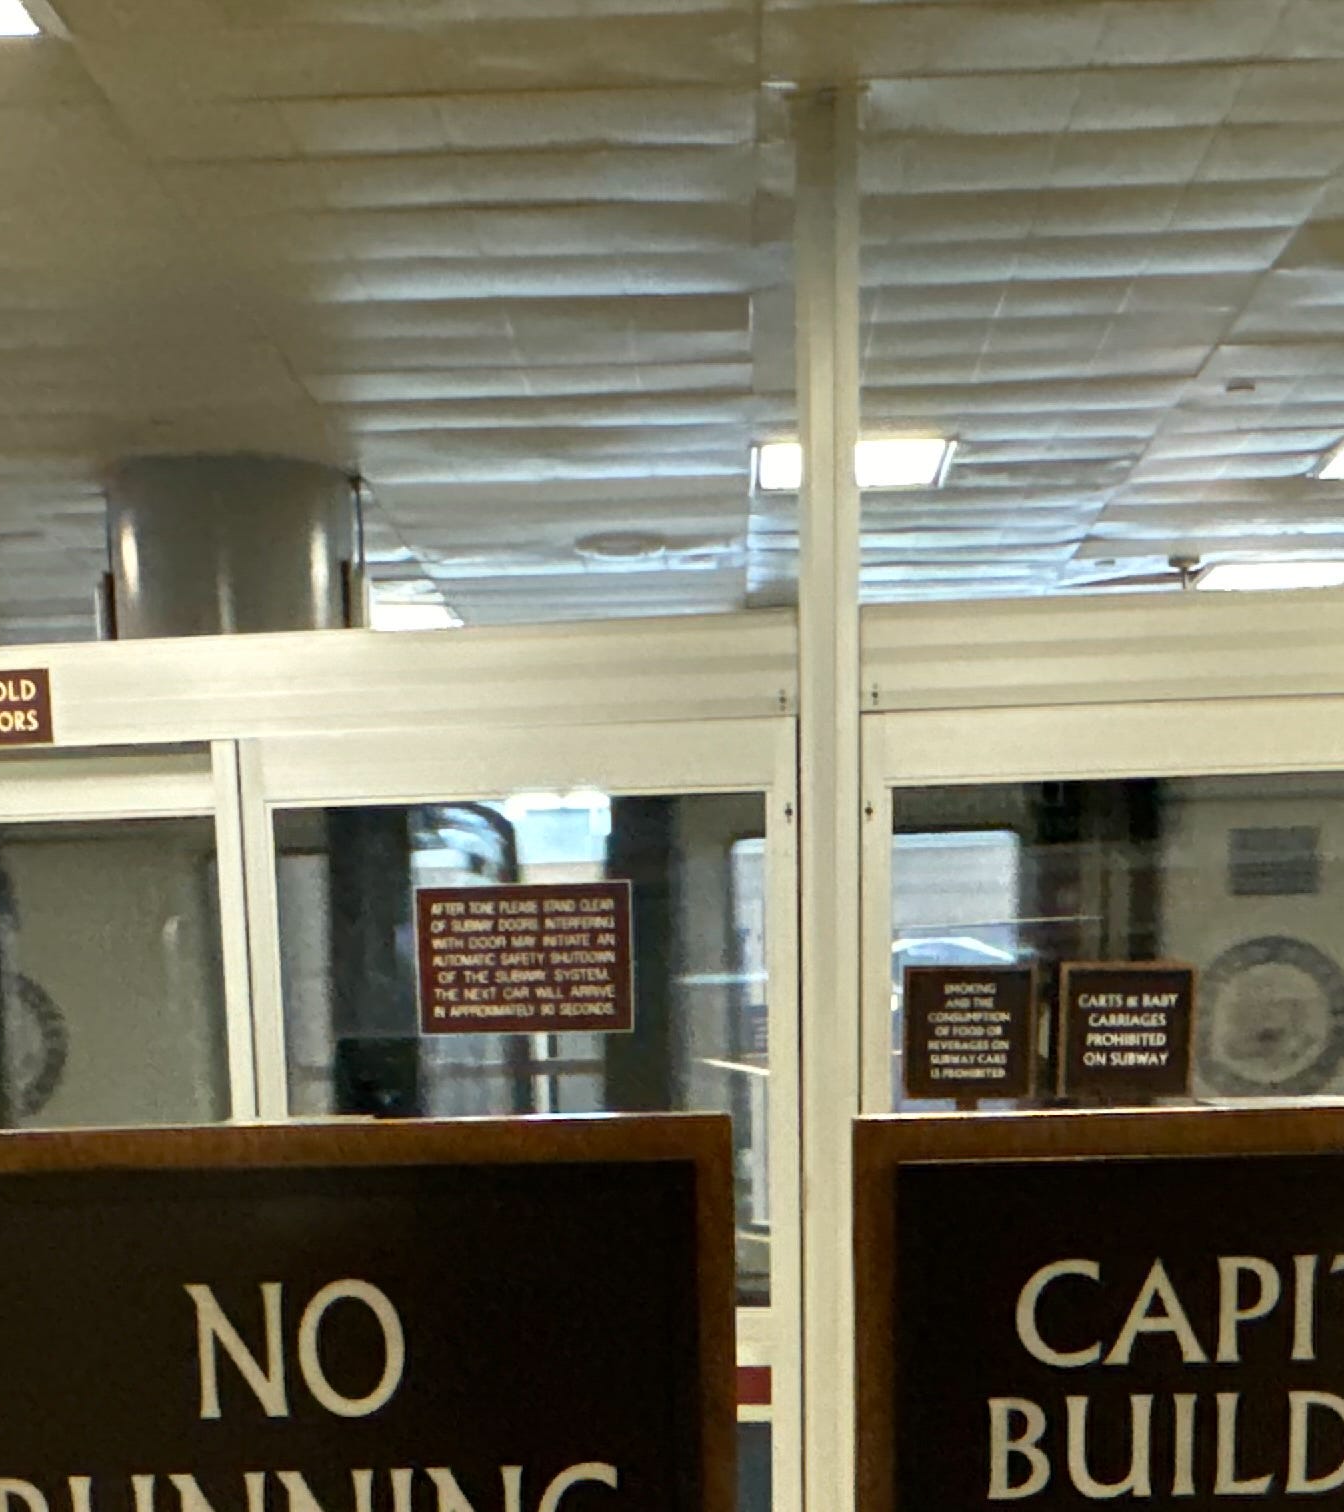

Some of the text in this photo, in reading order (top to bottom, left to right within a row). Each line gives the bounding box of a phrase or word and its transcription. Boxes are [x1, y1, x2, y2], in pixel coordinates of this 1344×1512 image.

[431, 898, 615, 915] AFTER TONE PLEASE STAND CLEAR
[431, 920, 446, 933] OF
[451, 919, 495, 932] SUBWAY
[544, 915, 615, 929] INTERFERING
[432, 933, 616, 950] WITH DOOR MAY INITIATE AN
[433, 951, 616, 967] AUTOMATIC SAFETY SHUTDOWN
[438, 971, 456, 984] OF
[463, 971, 489, 984] THE
[495, 969, 546, 983] SUBWAY
[434, 984, 615, 1000] THE NEXT CAR WILL ARRIVE
[945, 983, 997, 995] SMOKING
[945, 997, 994, 1009] AND THE
[1078, 993, 1123, 1008] CARTS
[1143, 993, 1179, 1008] BABY
[434, 1006, 446, 1018] IN
[450, 1004, 535, 1018] APPROXIMATELY
[927, 1012, 1011, 1024] CONSUMPTION
[1088, 1013, 1166, 1027] CARRIAGES
[934, 1025, 1003, 1037] OF FOOD OR
[928, 1040, 1009, 1051] BEVERAGES ON
[1086, 1033, 1166, 1047] PROHIBITED
[930, 1054, 1007, 1066] SUBWAY CARS
[1083, 1052, 1169, 1067] ON SUBWAY
[931, 1067, 1006, 1080] IS PROHIBITED
[183, 1277, 406, 1421] NO
